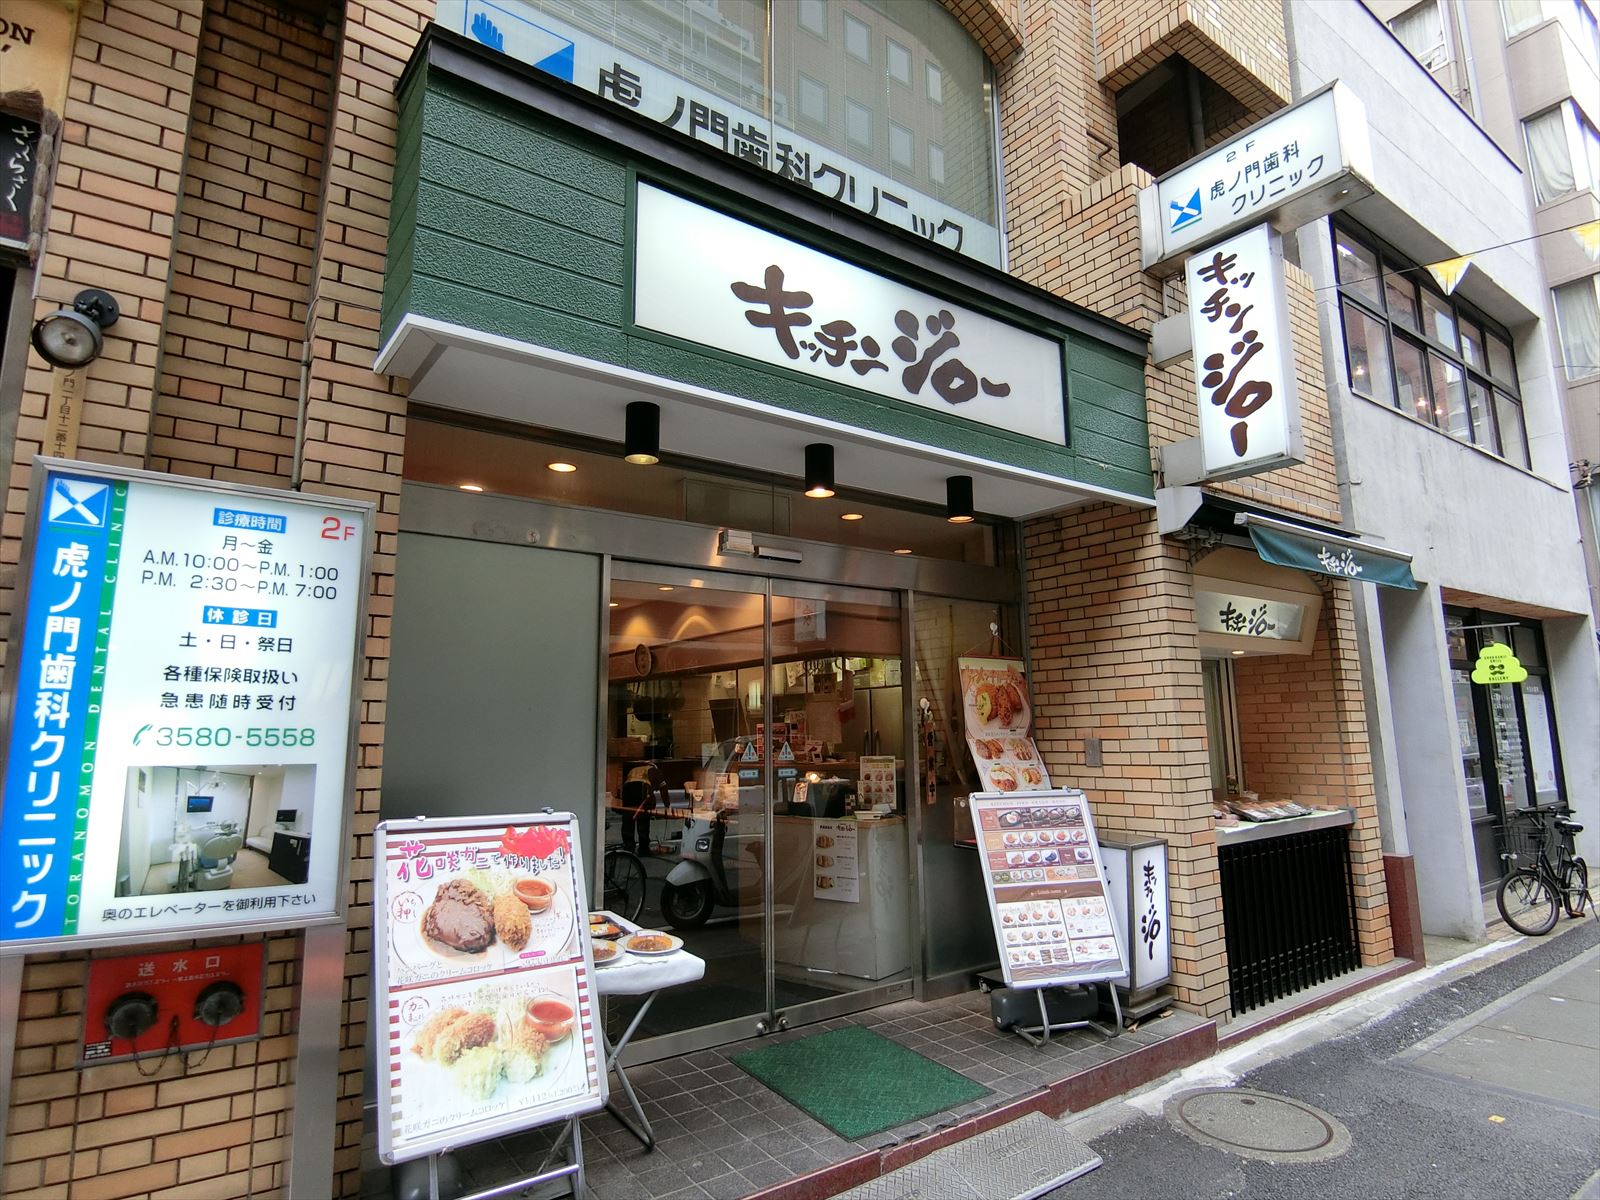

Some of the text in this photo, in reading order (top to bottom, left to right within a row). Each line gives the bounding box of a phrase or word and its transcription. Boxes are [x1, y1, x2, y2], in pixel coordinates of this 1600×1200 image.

[1210, 140, 1300, 201] 虎ノ門歯科
[1231, 154, 1324, 215] クリニック
[730, 264, 1011, 405] キッチンジロー
[1197, 251, 1272, 457] キッチンジロー
[217, 511, 282, 532] 診療時間
[321, 516, 356, 541] 2F
[222, 535, 274, 556] 月～金
[141, 570, 176, 587] P.M.
[295, 583, 337, 600] 7:00
[299, 564, 339, 581] 1:00
[207, 608, 273, 626] 休診日
[1219, 601, 1276, 636] キッチンジロー
[179, 631, 293, 653] 土・日・祭日
[163, 664, 299, 685] 各種保険取扱い
[64, 487, 128, 926] TORANOMON DENTAL CLINIC
[160, 691, 297, 712] 急患随時受付
[11, 541, 90, 929] 虎ノ門歯科クリニック
[156, 727, 316, 748] 3580-5558
[102, 893, 316, 922] 奥のエレベーターを御利用下さい
[138, 955, 221, 977] 送水口
